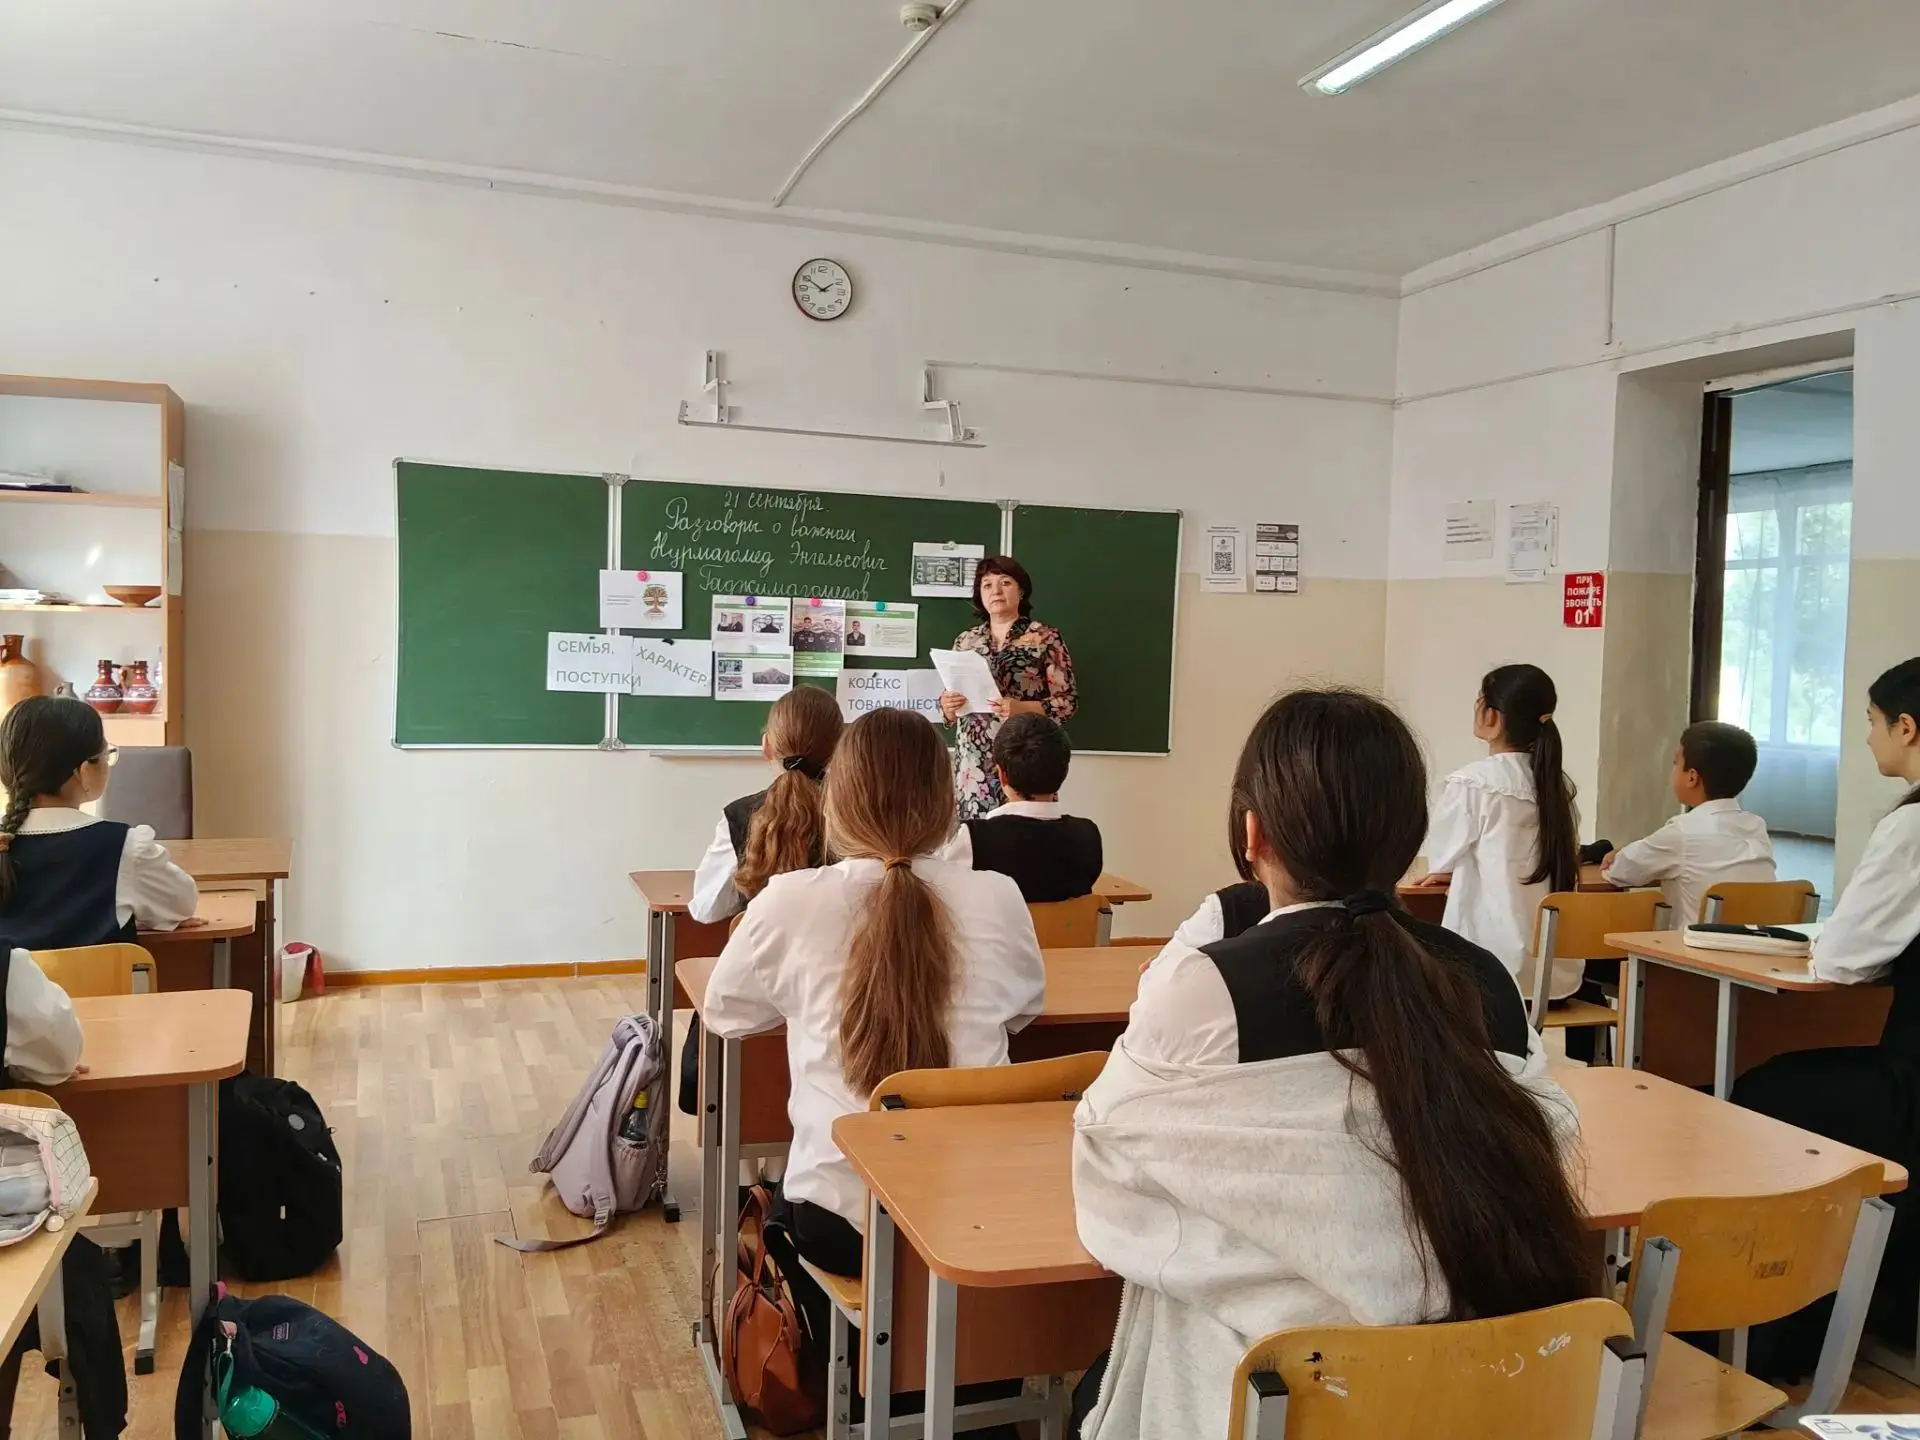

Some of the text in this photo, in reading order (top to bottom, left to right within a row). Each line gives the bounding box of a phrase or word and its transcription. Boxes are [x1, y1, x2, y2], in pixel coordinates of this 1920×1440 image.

[724, 490, 740, 508] 21
[665, 496, 763, 545] Разговоры
[772, 522, 782, 534] о
[650, 531, 888, 578] Нурмагомед Энгельсович
[699, 564, 869, 601] Гаджимагомедов
[1576, 575, 1593, 584] ПРИ
[558, 640, 614, 655] СЕМЬЯ.
[636, 646, 708, 687] ХАРАКТЕР.
[556, 670, 641, 687] ПОСТУПКИ
[848, 677, 901, 690] КОДЕКС
